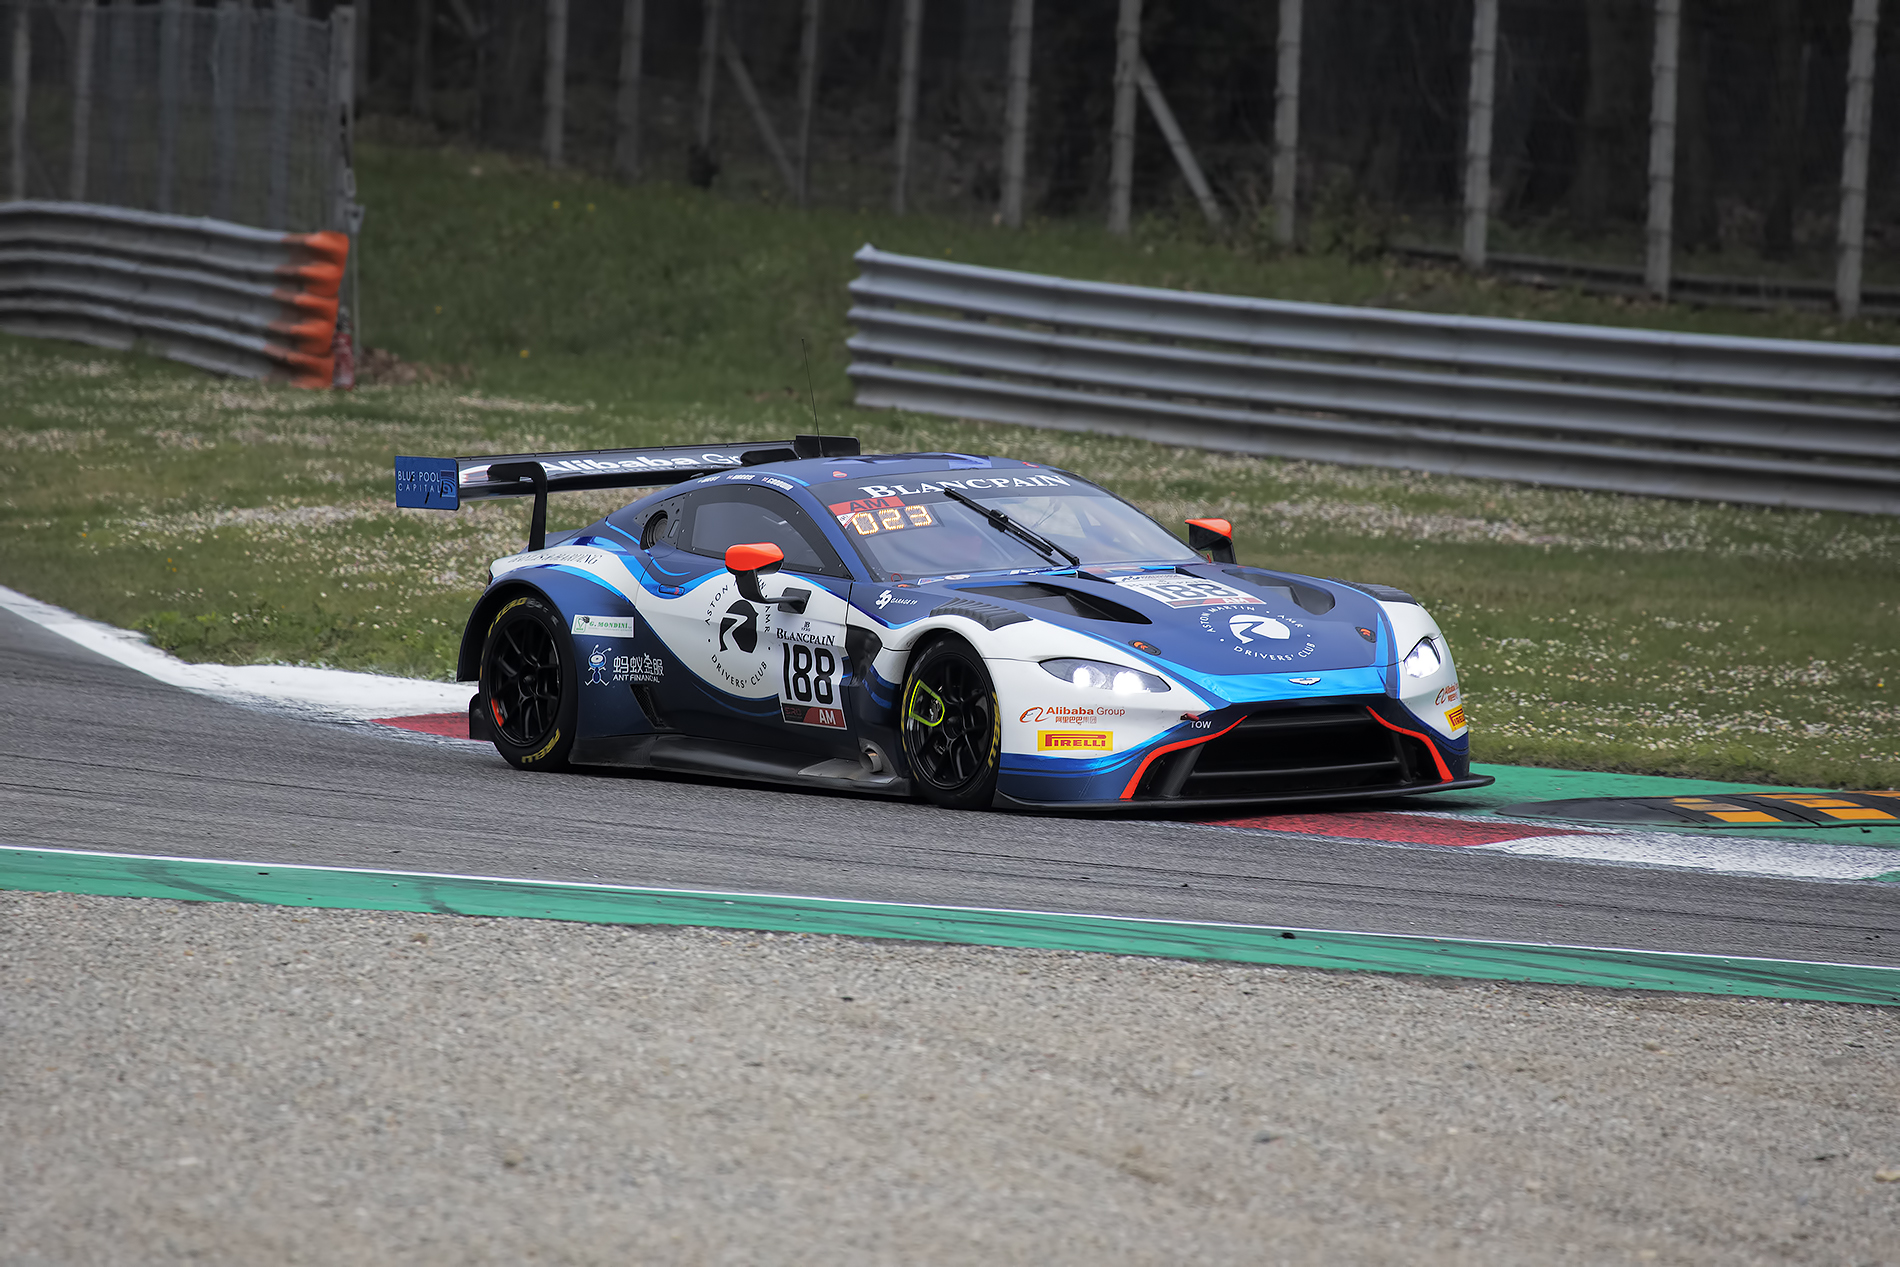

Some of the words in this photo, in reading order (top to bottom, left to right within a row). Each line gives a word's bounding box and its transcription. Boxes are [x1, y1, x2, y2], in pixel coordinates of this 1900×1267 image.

[538, 456, 701, 474] Alibaba
[419, 471, 440, 483] POOL
[397, 483, 441, 494] CAPITAL
[858, 474, 1071, 499] BLANCPAIN
[850, 498, 890, 512] AM
[852, 504, 933, 536] 023
[1140, 583, 1240, 600] 188
[704, 584, 729, 626] ASTON
[598, 621, 629, 629] MONDINI
[776, 627, 836, 647] BLANCPAIN
[1233, 645, 1295, 661] DRIVERS'
[1297, 641, 1316, 658] CLUB
[612, 652, 665, 677] 蚂蚁金服
[750, 660, 768, 687] CLUB
[782, 642, 836, 705] 188
[612, 673, 630, 682] ANT
[819, 708, 837, 726] AM
[1045, 706, 1094, 716] Alibaba
[1096, 706, 1126, 717] Group
[1190, 720, 1212, 729] TOW
[1044, 733, 1107, 747] PIRELLI
